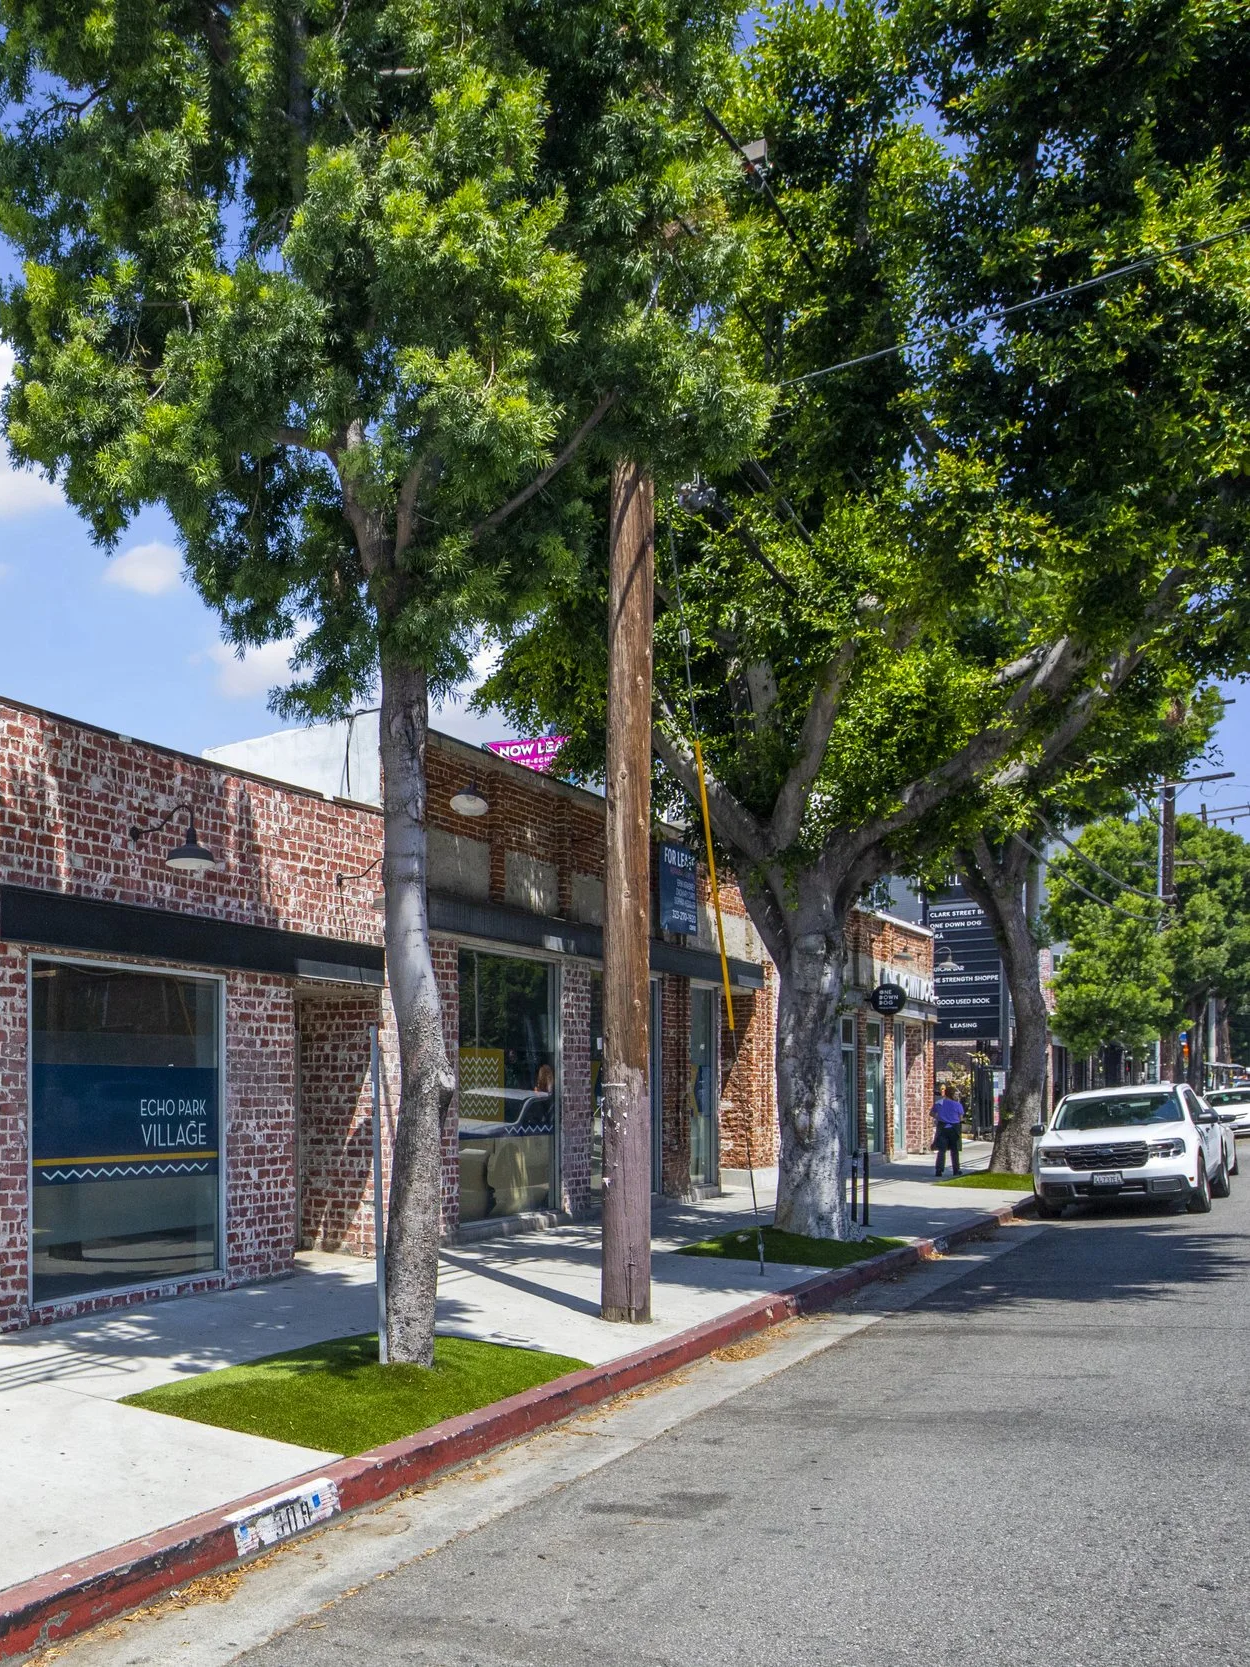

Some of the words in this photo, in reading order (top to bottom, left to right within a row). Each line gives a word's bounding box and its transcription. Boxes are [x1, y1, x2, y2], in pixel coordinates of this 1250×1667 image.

[499, 743, 535, 758] NOW
[664, 847, 677, 866] FOR
[942, 975, 973, 983] STRENGTH
[140, 1099, 175, 1117] ECHO
[178, 1099, 207, 1116] PARK
